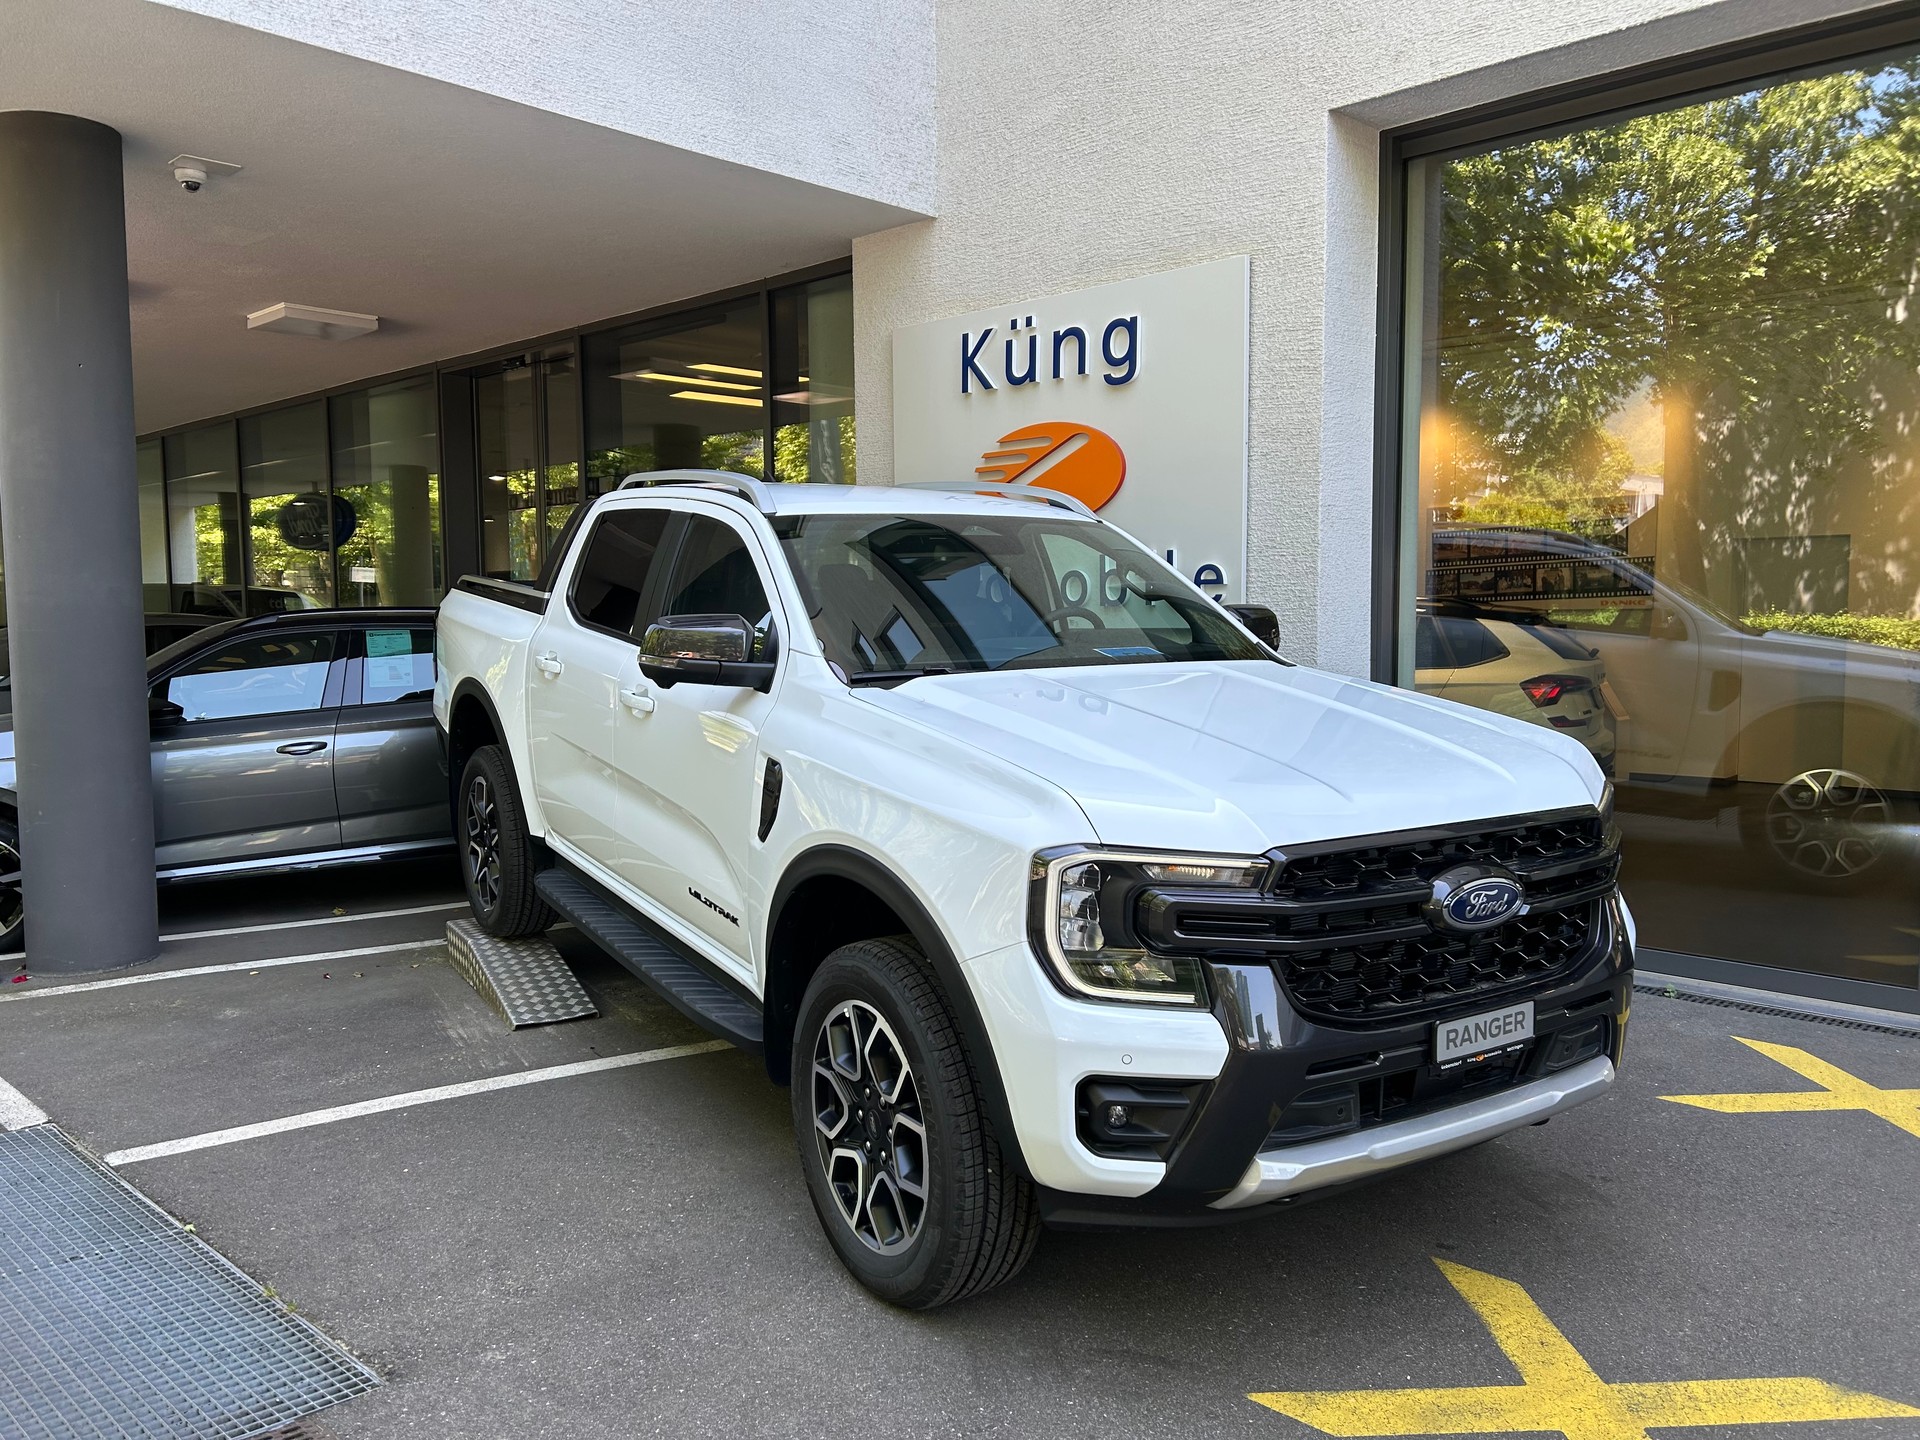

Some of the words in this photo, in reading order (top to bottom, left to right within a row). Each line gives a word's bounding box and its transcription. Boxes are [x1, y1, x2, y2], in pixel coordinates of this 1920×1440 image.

[960, 314, 1141, 394] Küng
[1466, 890, 1507, 918] Ford
[1446, 1010, 1525, 1050] RANGER
